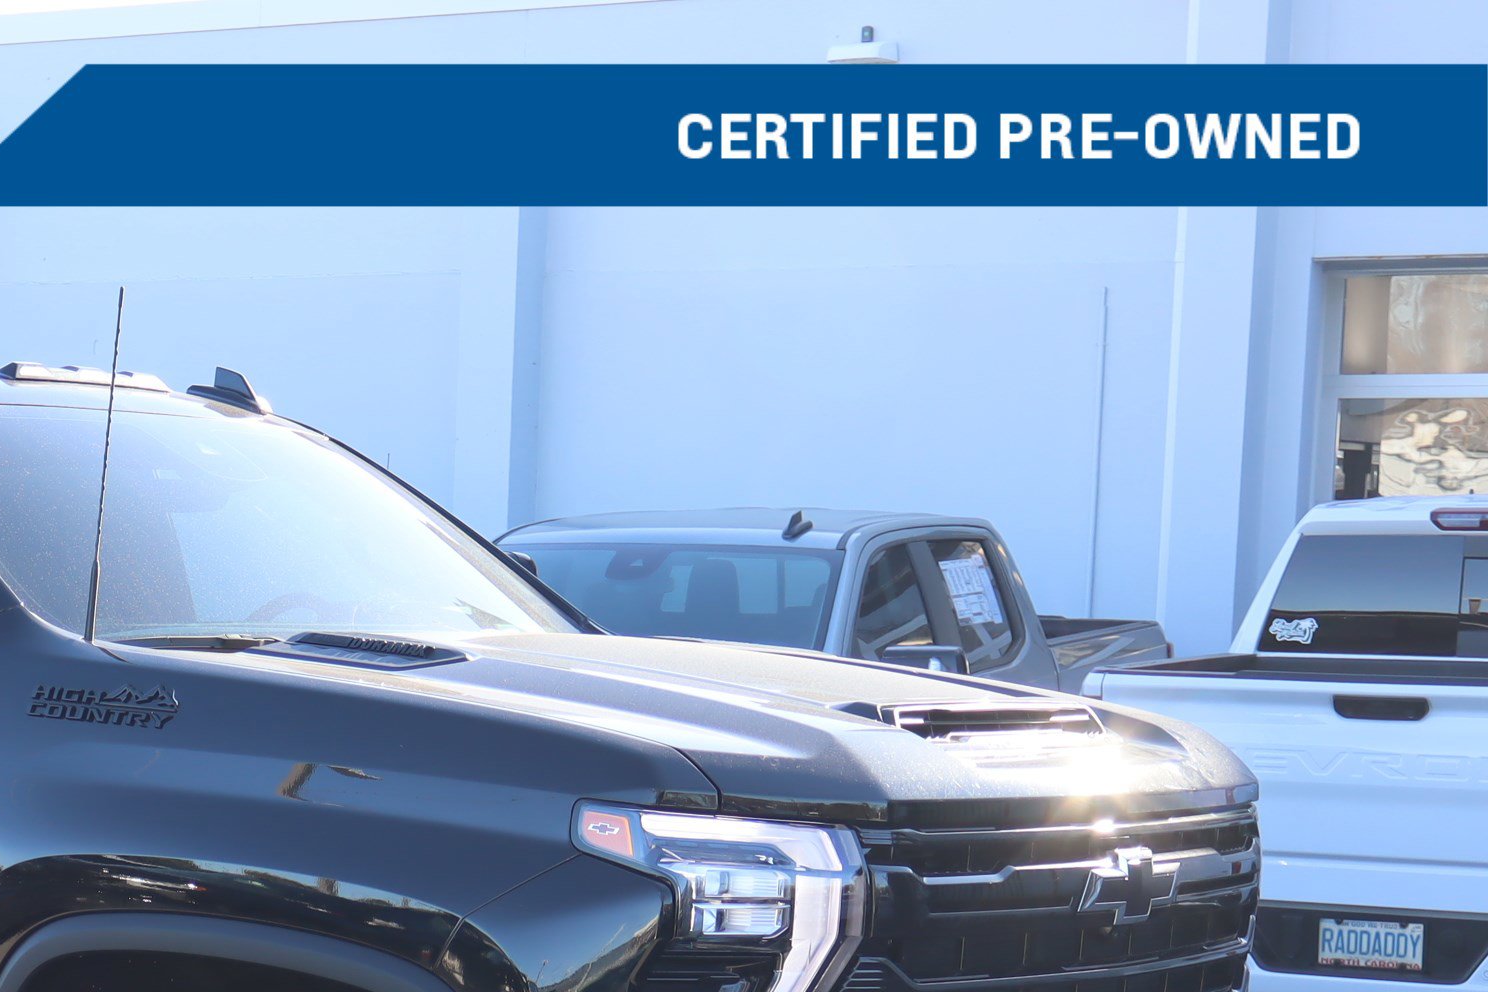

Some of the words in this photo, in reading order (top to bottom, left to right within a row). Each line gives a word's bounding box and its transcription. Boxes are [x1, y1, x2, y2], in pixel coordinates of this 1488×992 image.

[31, 684, 109, 706] HIGH
[26, 702, 175, 730] COUNTRY
[1321, 927, 1420, 959] RADDADDY
